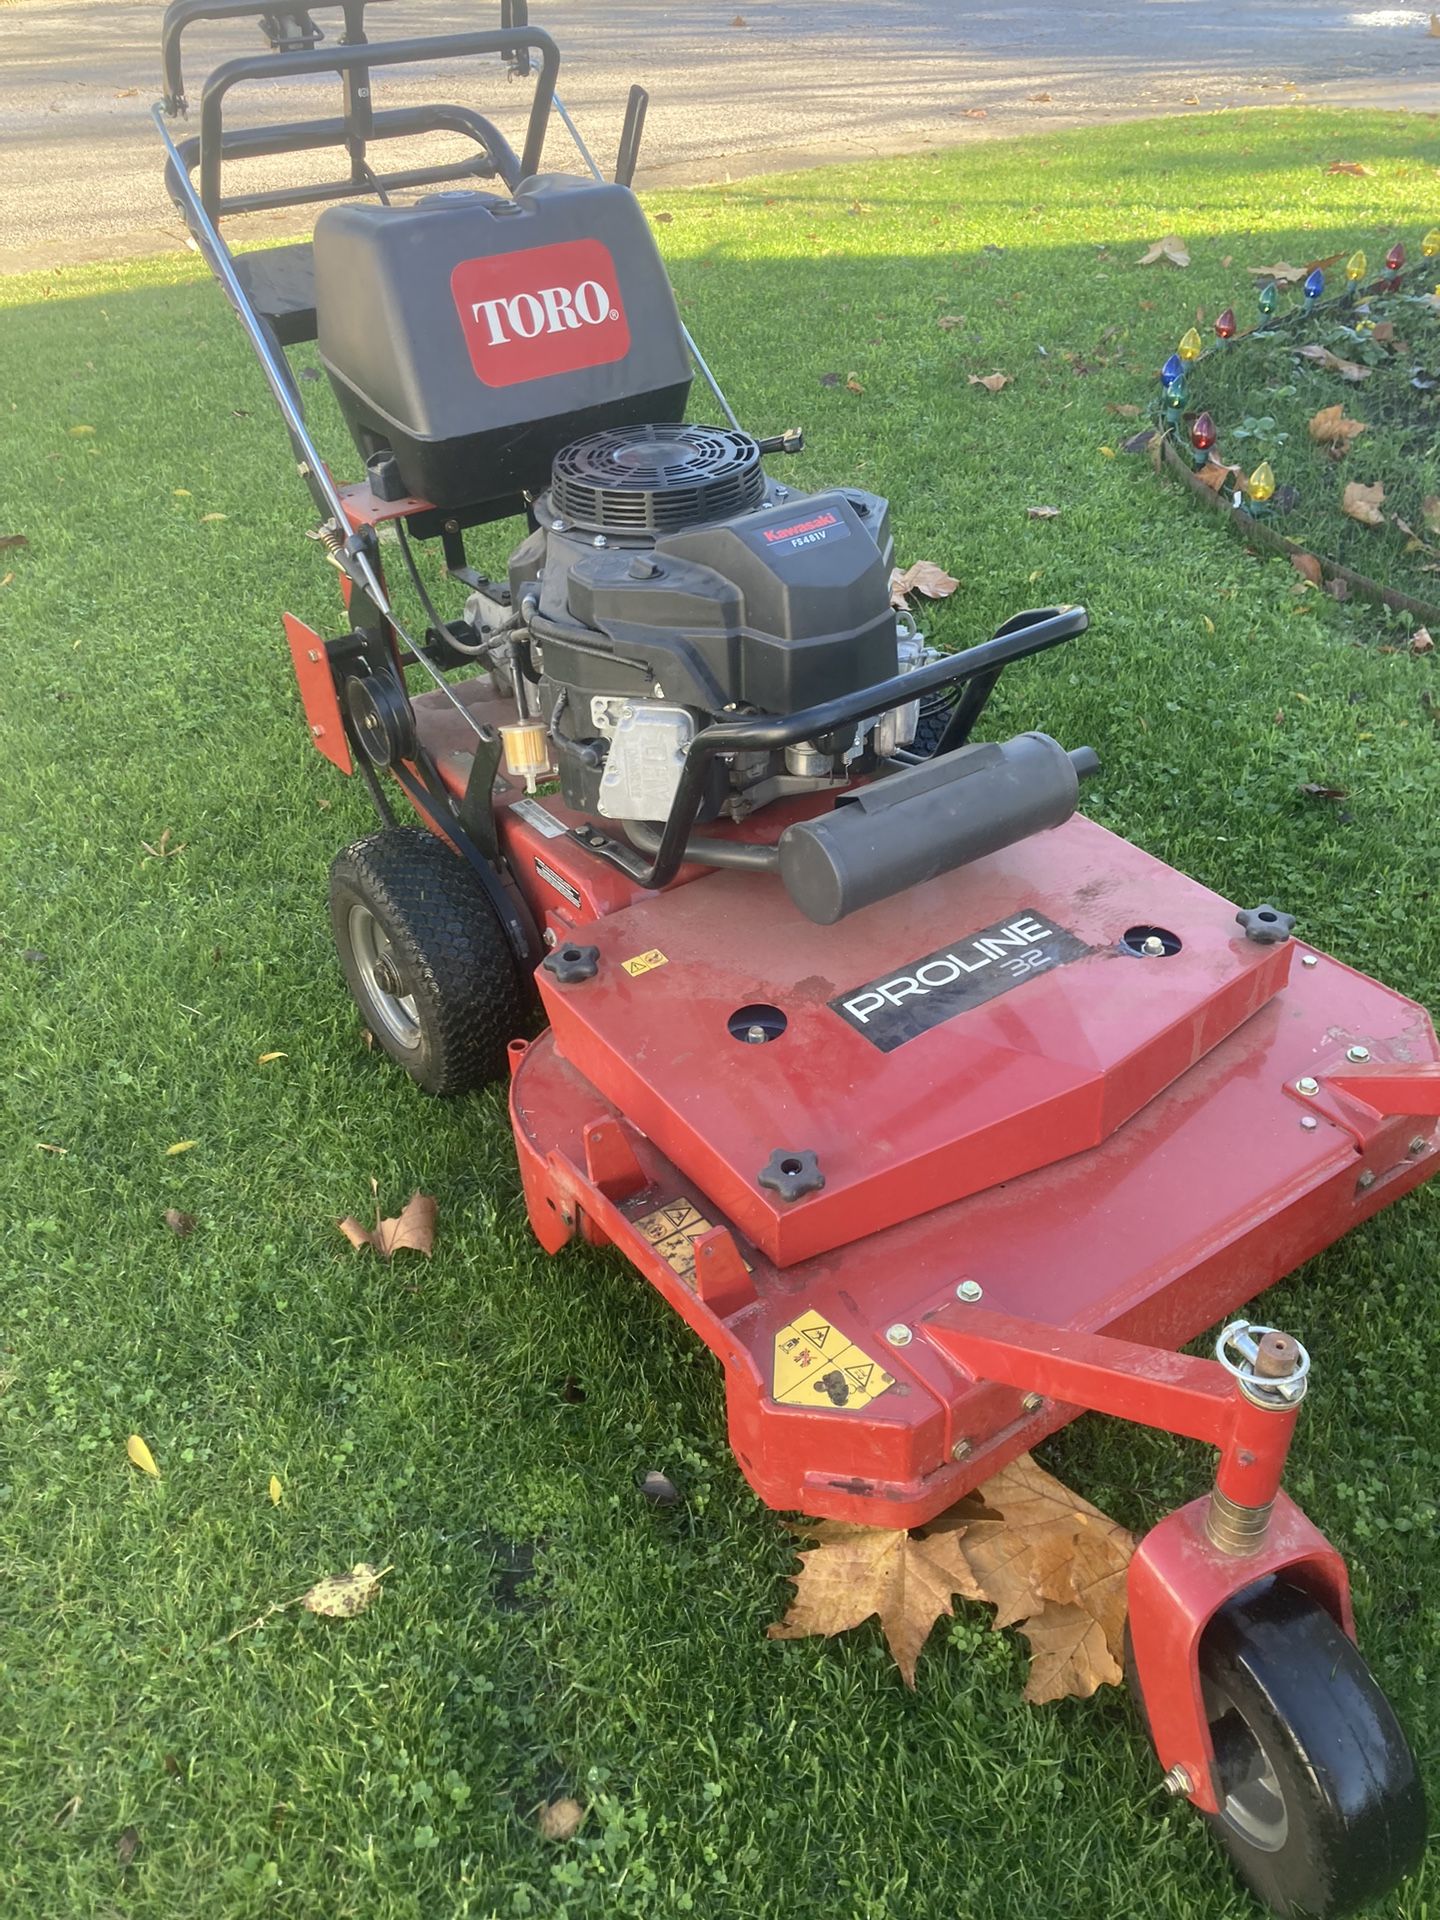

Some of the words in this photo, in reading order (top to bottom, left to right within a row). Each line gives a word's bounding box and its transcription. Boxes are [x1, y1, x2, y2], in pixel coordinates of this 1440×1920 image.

[763, 512, 837, 542] Kawasaki
[791, 530, 826, 548] FS481V
[842, 916, 1053, 1024] PROLINE
[999, 948, 1052, 977] 32
